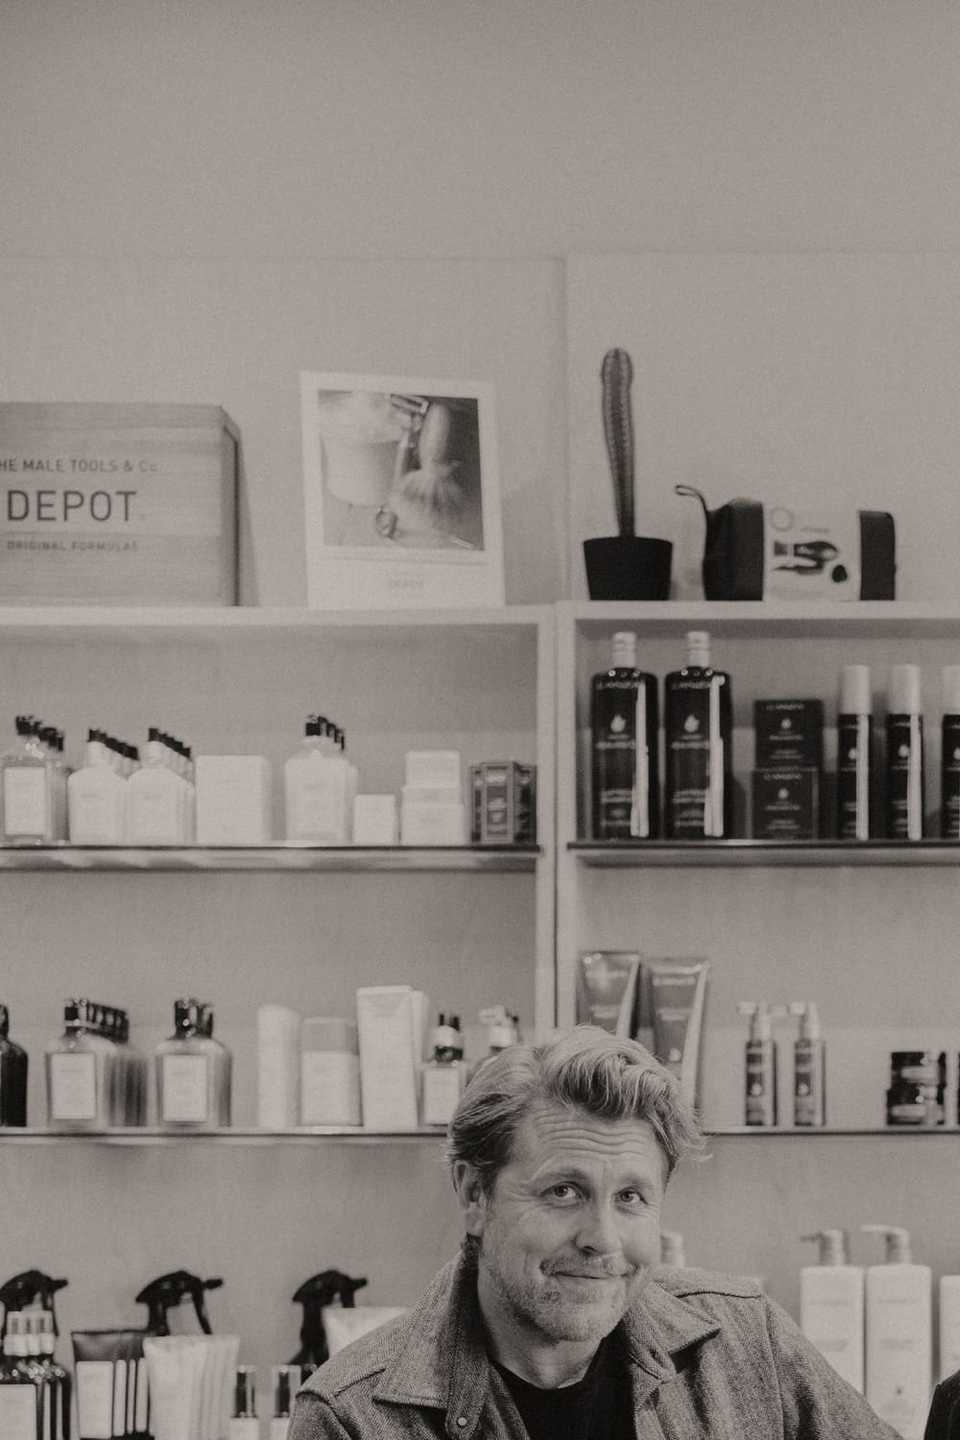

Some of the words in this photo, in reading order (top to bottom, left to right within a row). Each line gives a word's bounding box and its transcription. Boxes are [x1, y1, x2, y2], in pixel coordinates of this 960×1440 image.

[0, 459, 18, 472] HE
[23, 459, 65, 472] MALE
[71, 459, 118, 472] TOOLS
[7, 490, 138, 522] DEPOT
